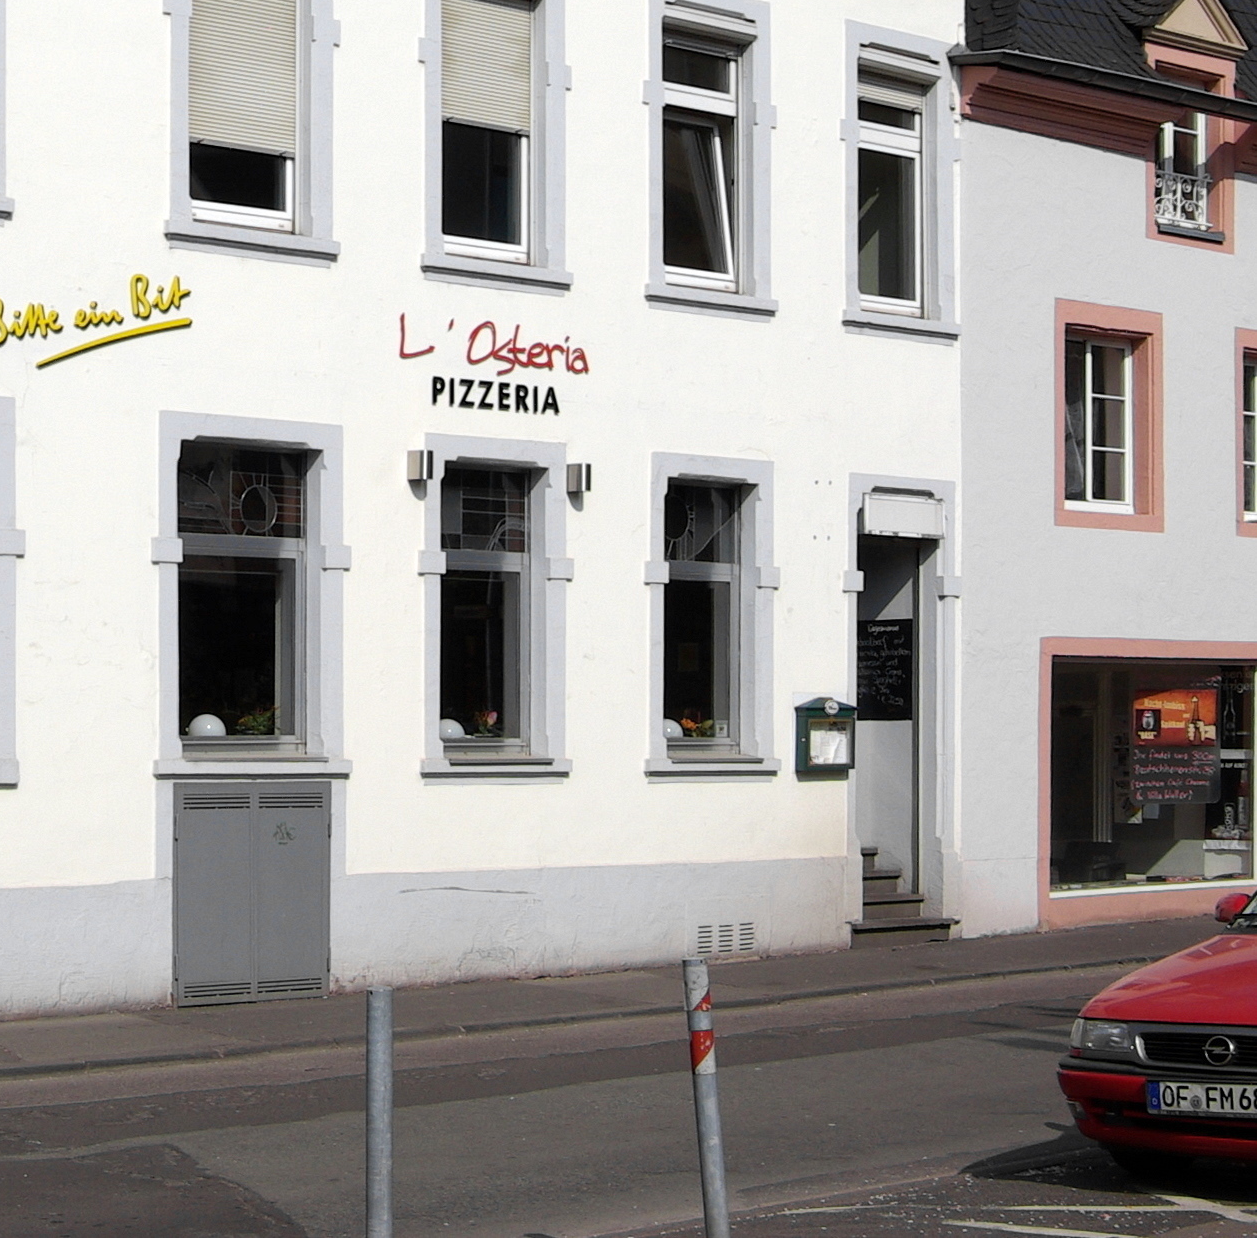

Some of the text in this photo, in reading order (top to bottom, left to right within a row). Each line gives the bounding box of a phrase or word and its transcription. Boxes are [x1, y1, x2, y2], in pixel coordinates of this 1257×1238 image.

[74, 301, 123, 330] ein
[130, 274, 191, 319] Bit
[432, 376, 560, 416] PIZZERIA
[1162, 1085, 1189, 1108] OF
[1205, 1087, 1234, 1110] FM
